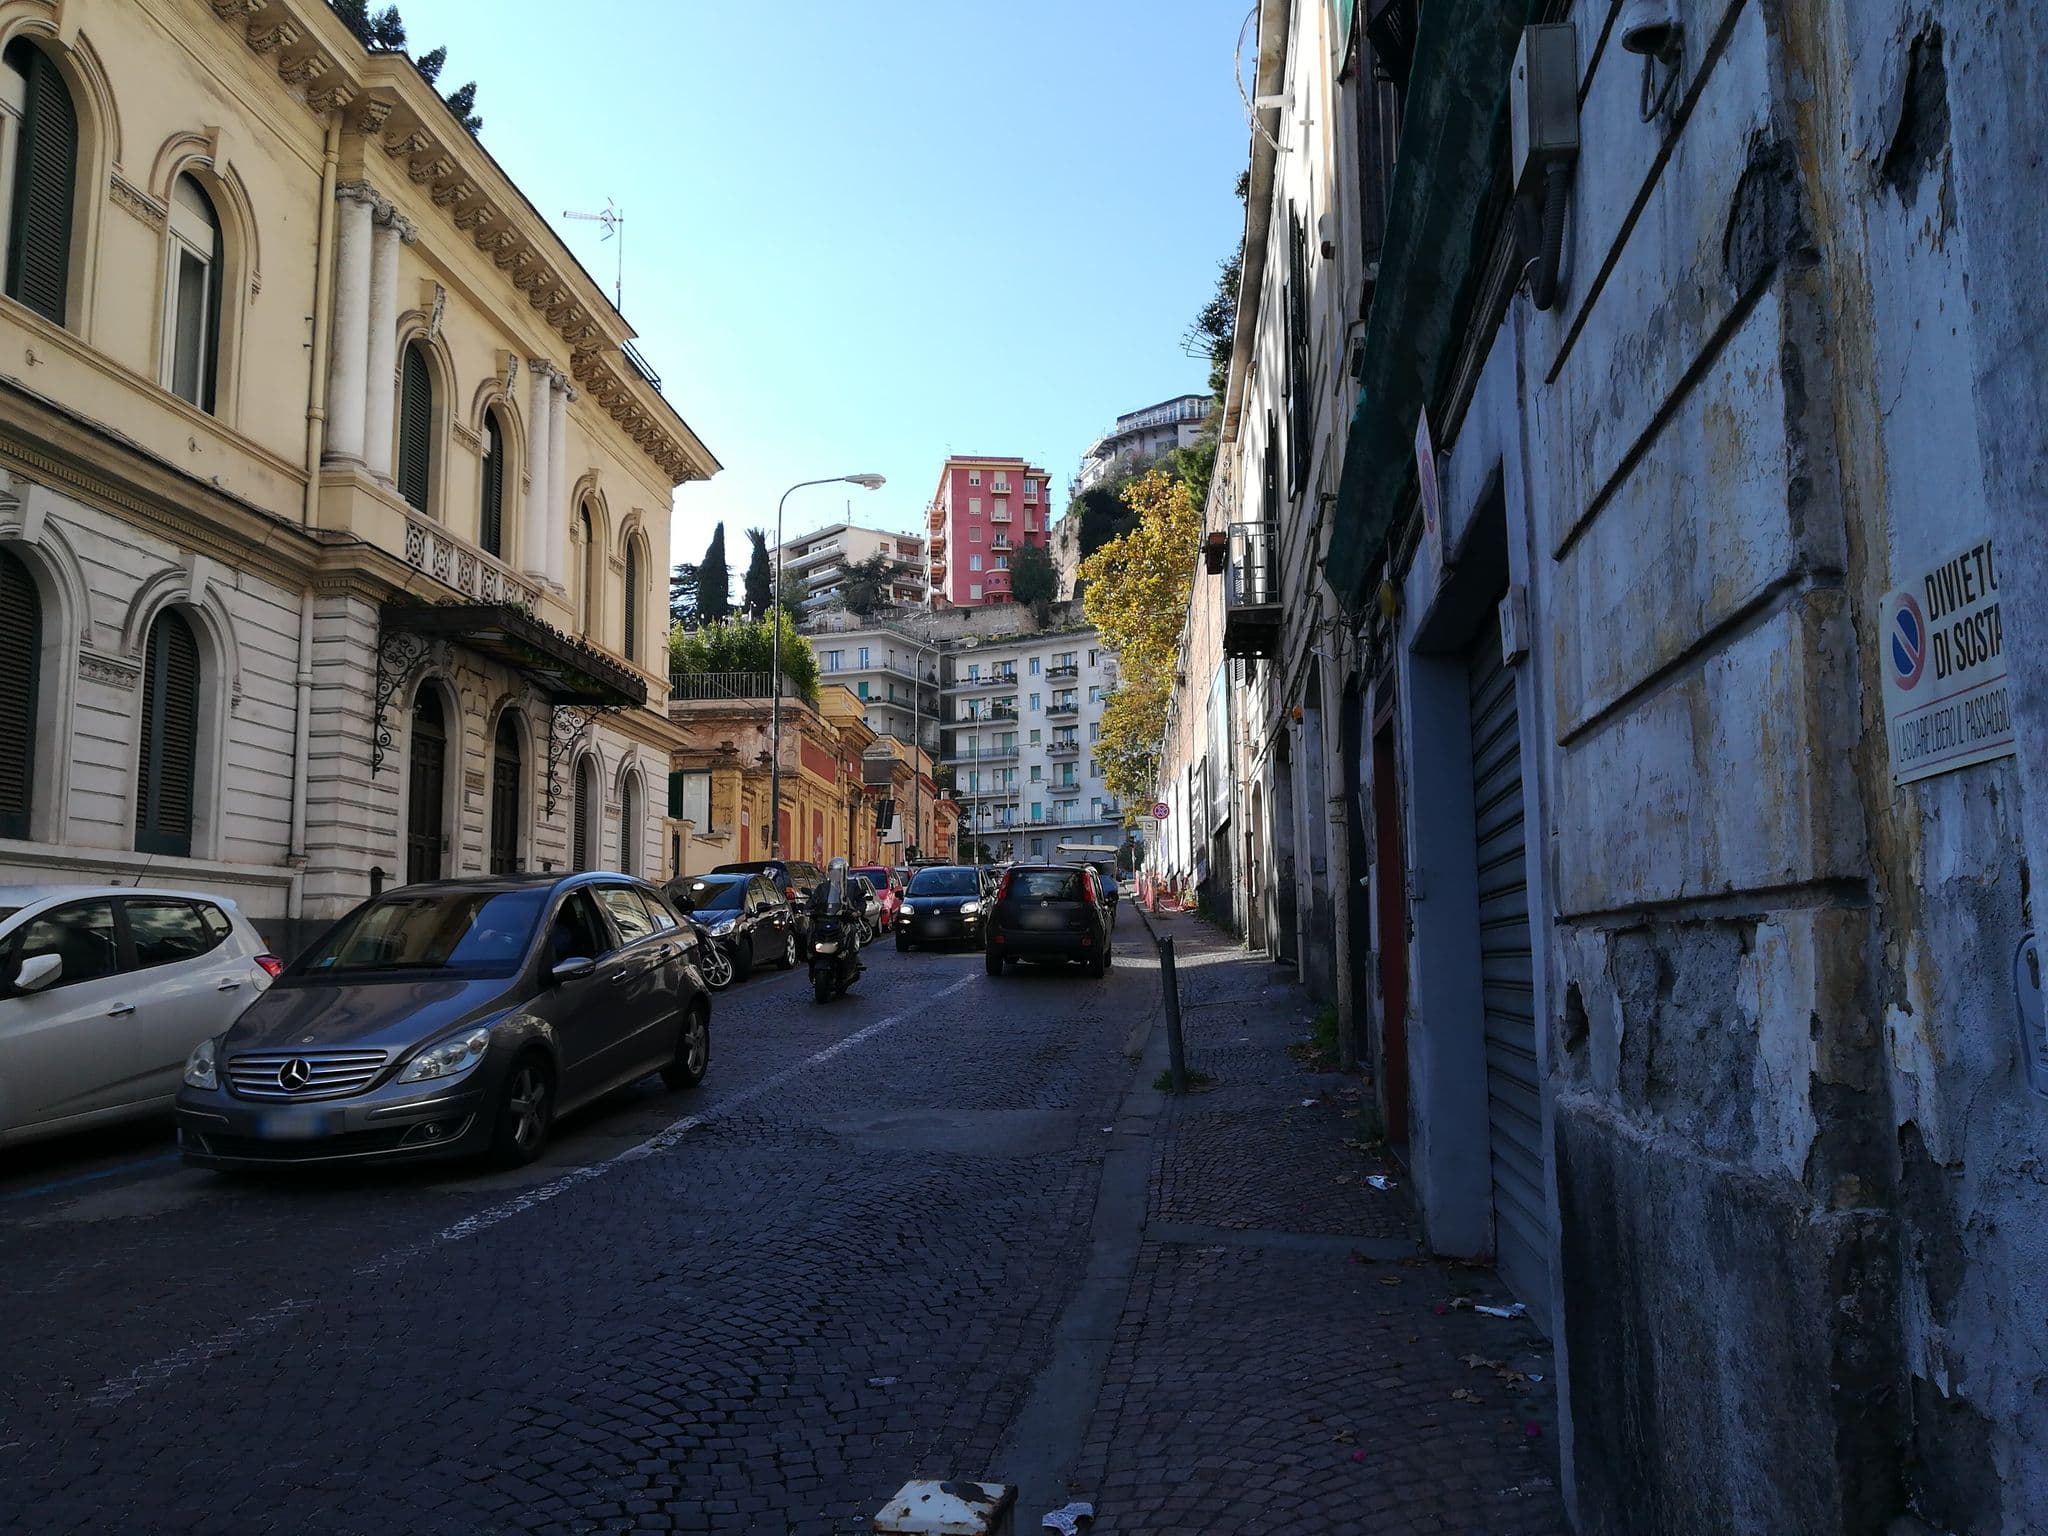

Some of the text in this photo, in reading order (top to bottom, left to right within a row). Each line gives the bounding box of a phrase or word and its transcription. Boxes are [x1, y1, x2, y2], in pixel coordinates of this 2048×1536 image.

[1933, 603, 2003, 680] DI SOSTA
[1898, 688, 2010, 762] LASCIARE LIBERO IL PASSAGGIO
